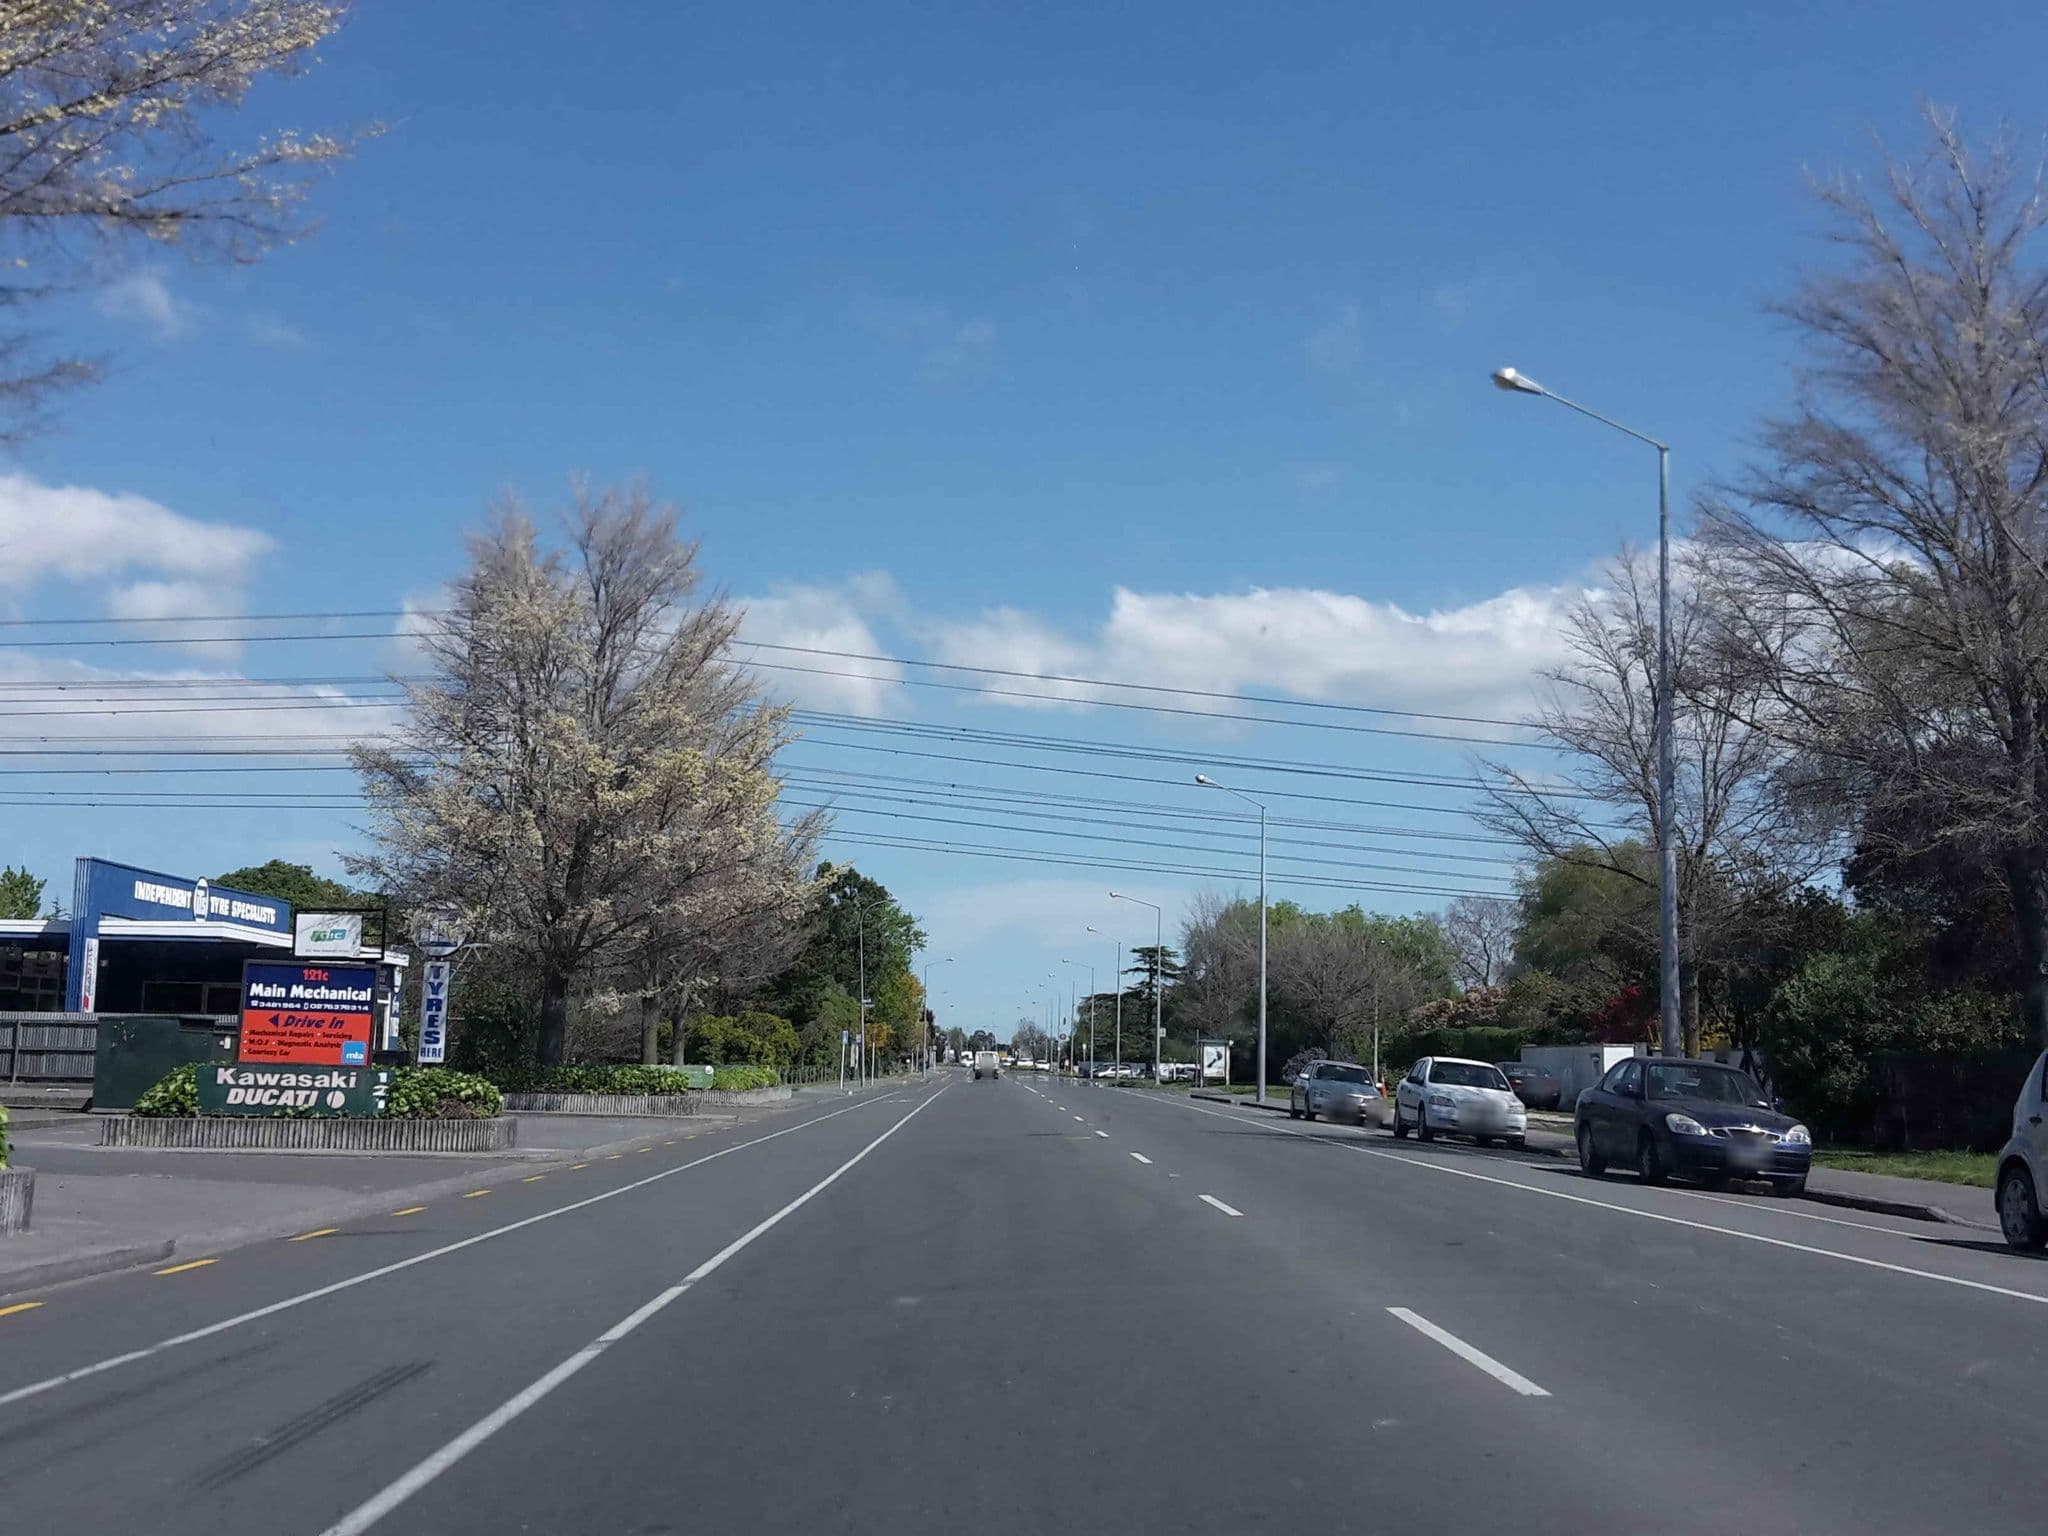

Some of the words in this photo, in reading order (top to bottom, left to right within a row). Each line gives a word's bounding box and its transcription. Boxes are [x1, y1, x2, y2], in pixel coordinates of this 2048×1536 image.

[134, 880, 192, 909] INDEPENDENT
[210, 896, 229, 915] TYRE
[231, 900, 276, 925] SPECIALISTS
[303, 969, 329, 981] 121c
[250, 983, 286, 998] Main
[290, 984, 372, 1001] Mechanical
[424, 965, 444, 1045] TYRES
[283, 1015, 324, 1029] Drive
[329, 1016, 345, 1029] In
[249, 1029, 287, 1037] Mechanical
[289, 1030, 314, 1039] Repairs
[323, 1032, 352, 1040] Servicing
[277, 1039, 311, 1048] Diagnostic
[247, 1048, 277, 1057] Courtesy
[346, 1051, 364, 1060] mta
[420, 1047, 442, 1058] HERE
[216, 1067, 357, 1089] Kawasaki
[226, 1088, 319, 1107] DUCATI
